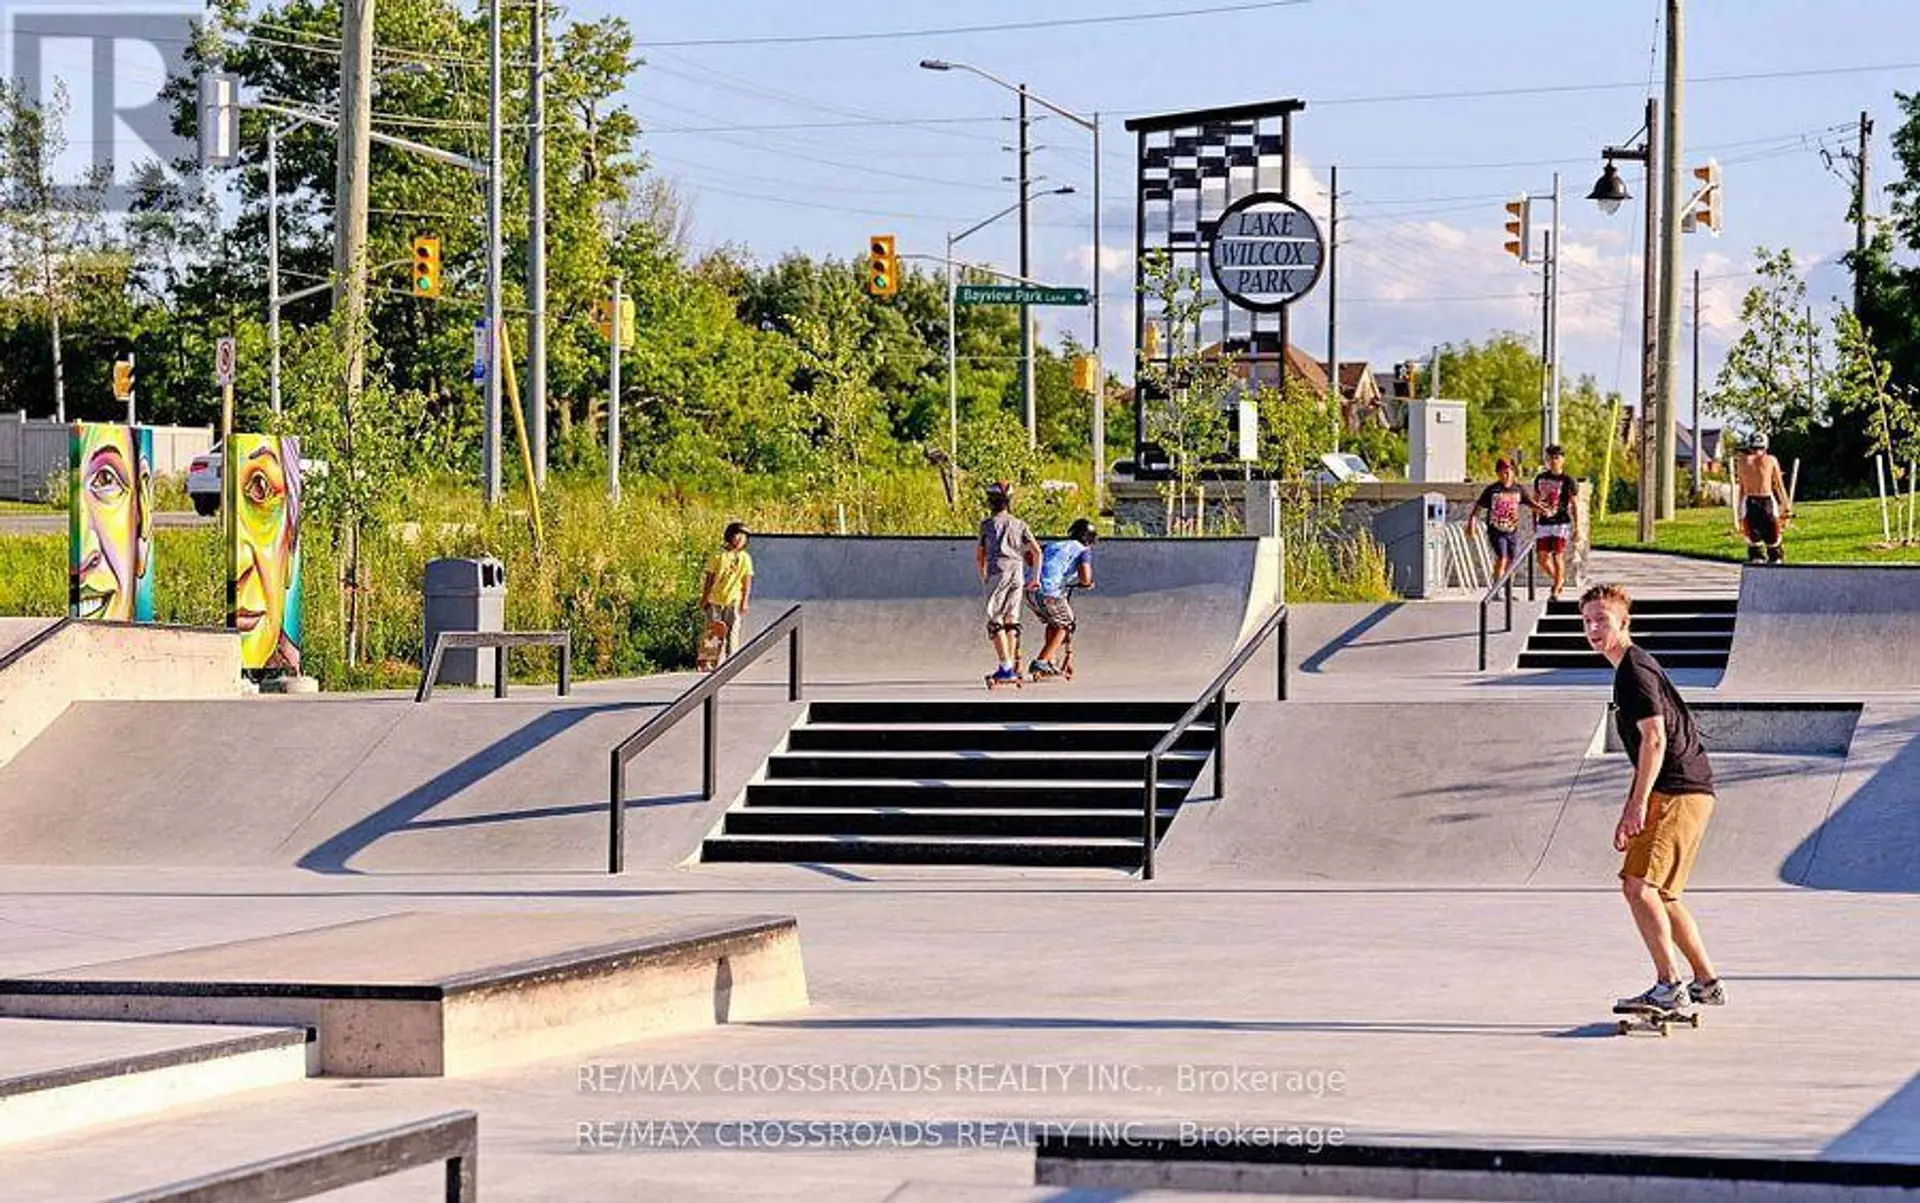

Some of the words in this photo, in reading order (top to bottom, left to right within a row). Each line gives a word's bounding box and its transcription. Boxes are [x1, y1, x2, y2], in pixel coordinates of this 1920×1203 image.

[1238, 213, 1296, 236] LAKE
[1222, 241, 1305, 266] WILCOX
[1238, 269, 1296, 293] PARK
[963, 288, 1013, 304] Bayview
[1015, 290, 1043, 301] Park
